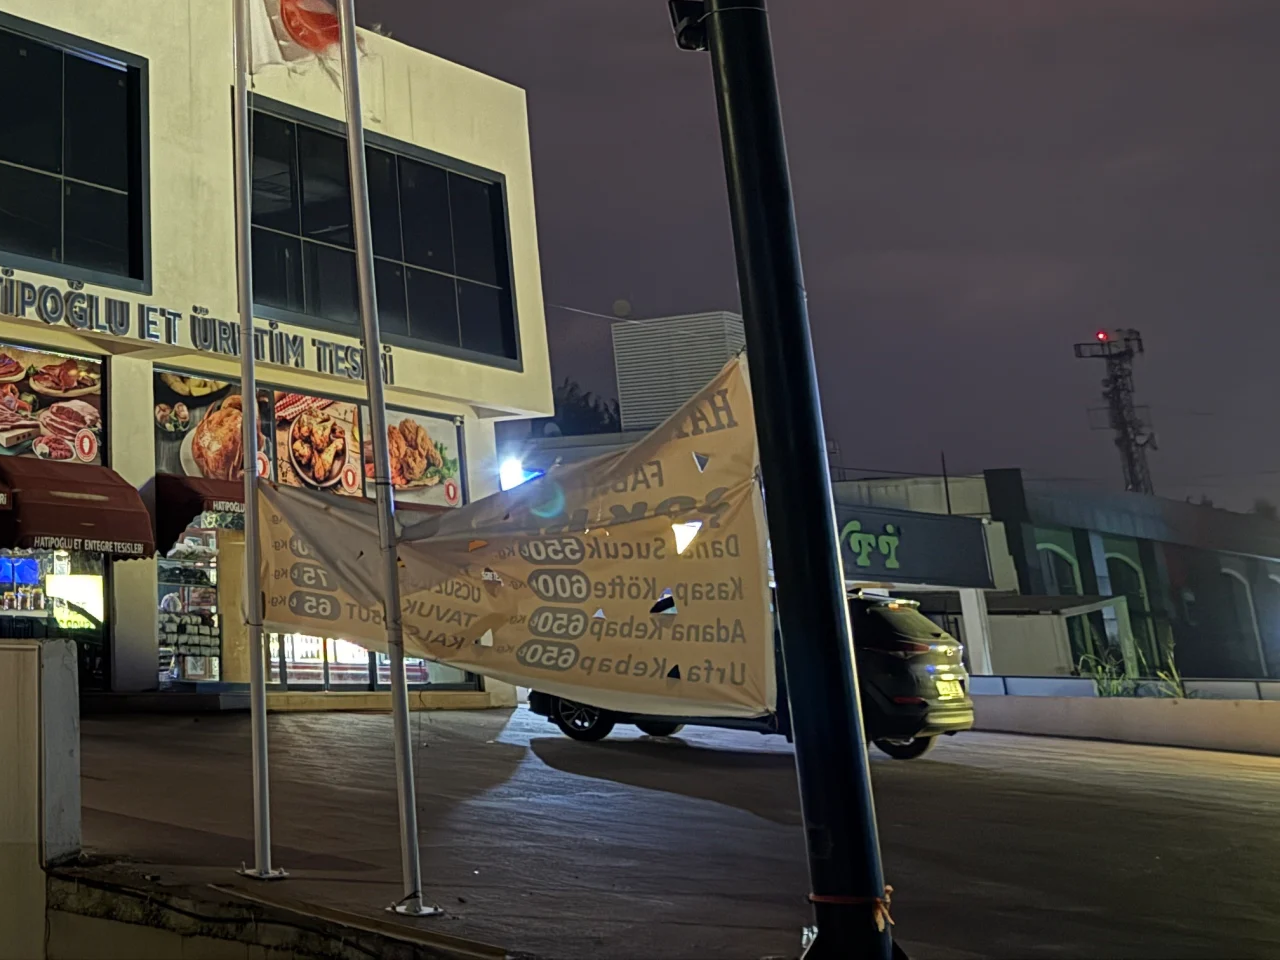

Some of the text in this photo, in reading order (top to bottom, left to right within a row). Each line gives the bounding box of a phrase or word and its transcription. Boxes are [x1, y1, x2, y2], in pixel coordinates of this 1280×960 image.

[140, 302, 183, 343] ET
[191, 305, 306, 369] ÜRTİM
[313, 338, 395, 385] TESİ
[73, 538, 83, 550] ET
[84, 540, 114, 553] ENTEGRE
